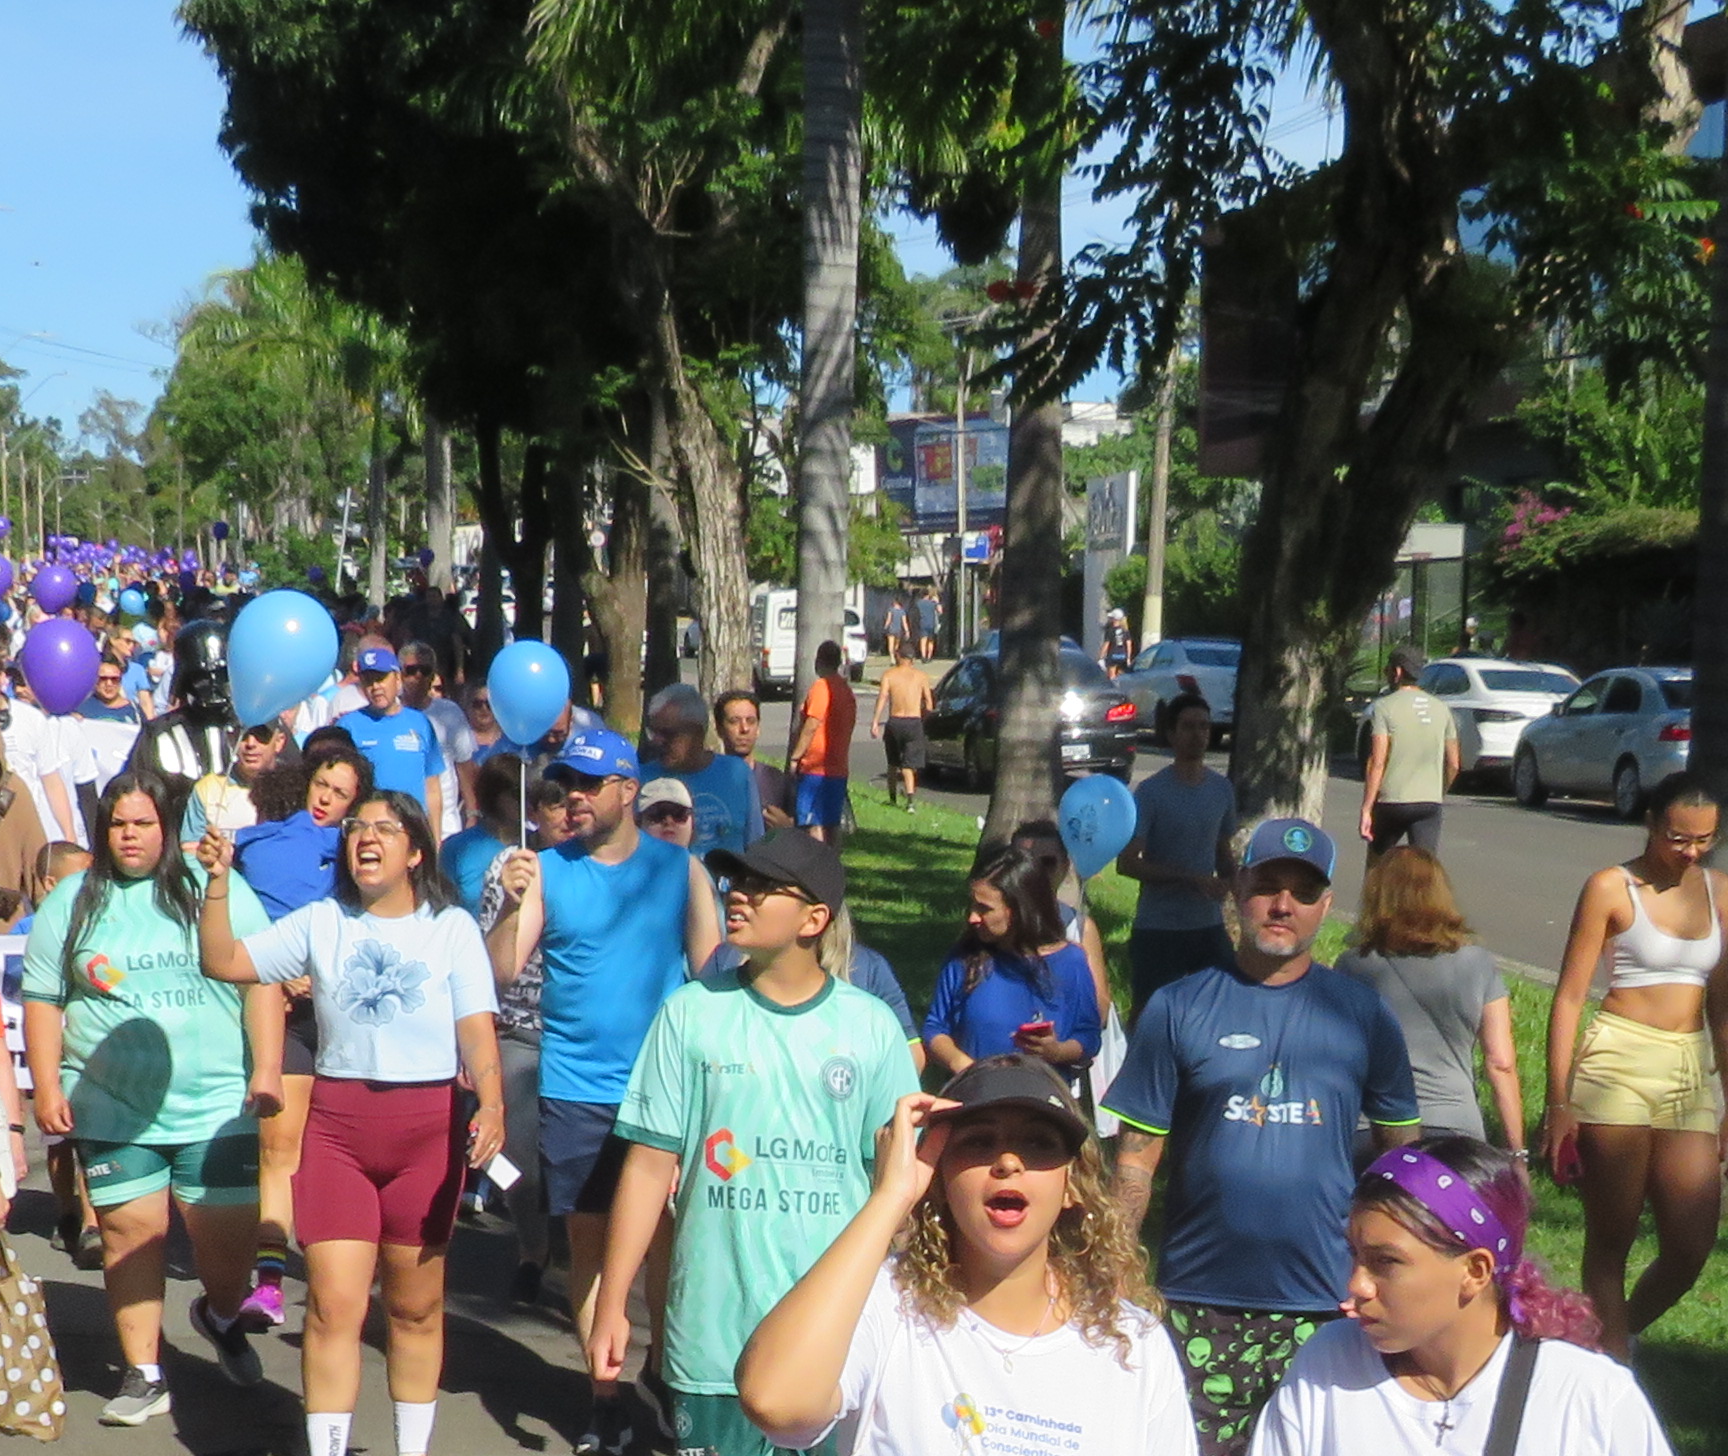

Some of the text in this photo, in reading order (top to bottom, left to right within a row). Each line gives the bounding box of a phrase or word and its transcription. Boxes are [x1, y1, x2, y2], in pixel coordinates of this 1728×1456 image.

[126, 951, 200, 971] LG Mot
[151, 988, 206, 1009] STORE
[755, 1136, 847, 1165] LG Mota
[707, 1185, 841, 1215] MEGA STORE
[1005, 1410, 1082, 1434] Caminhada
[986, 1423, 1080, 1450] Dia Mundial de
